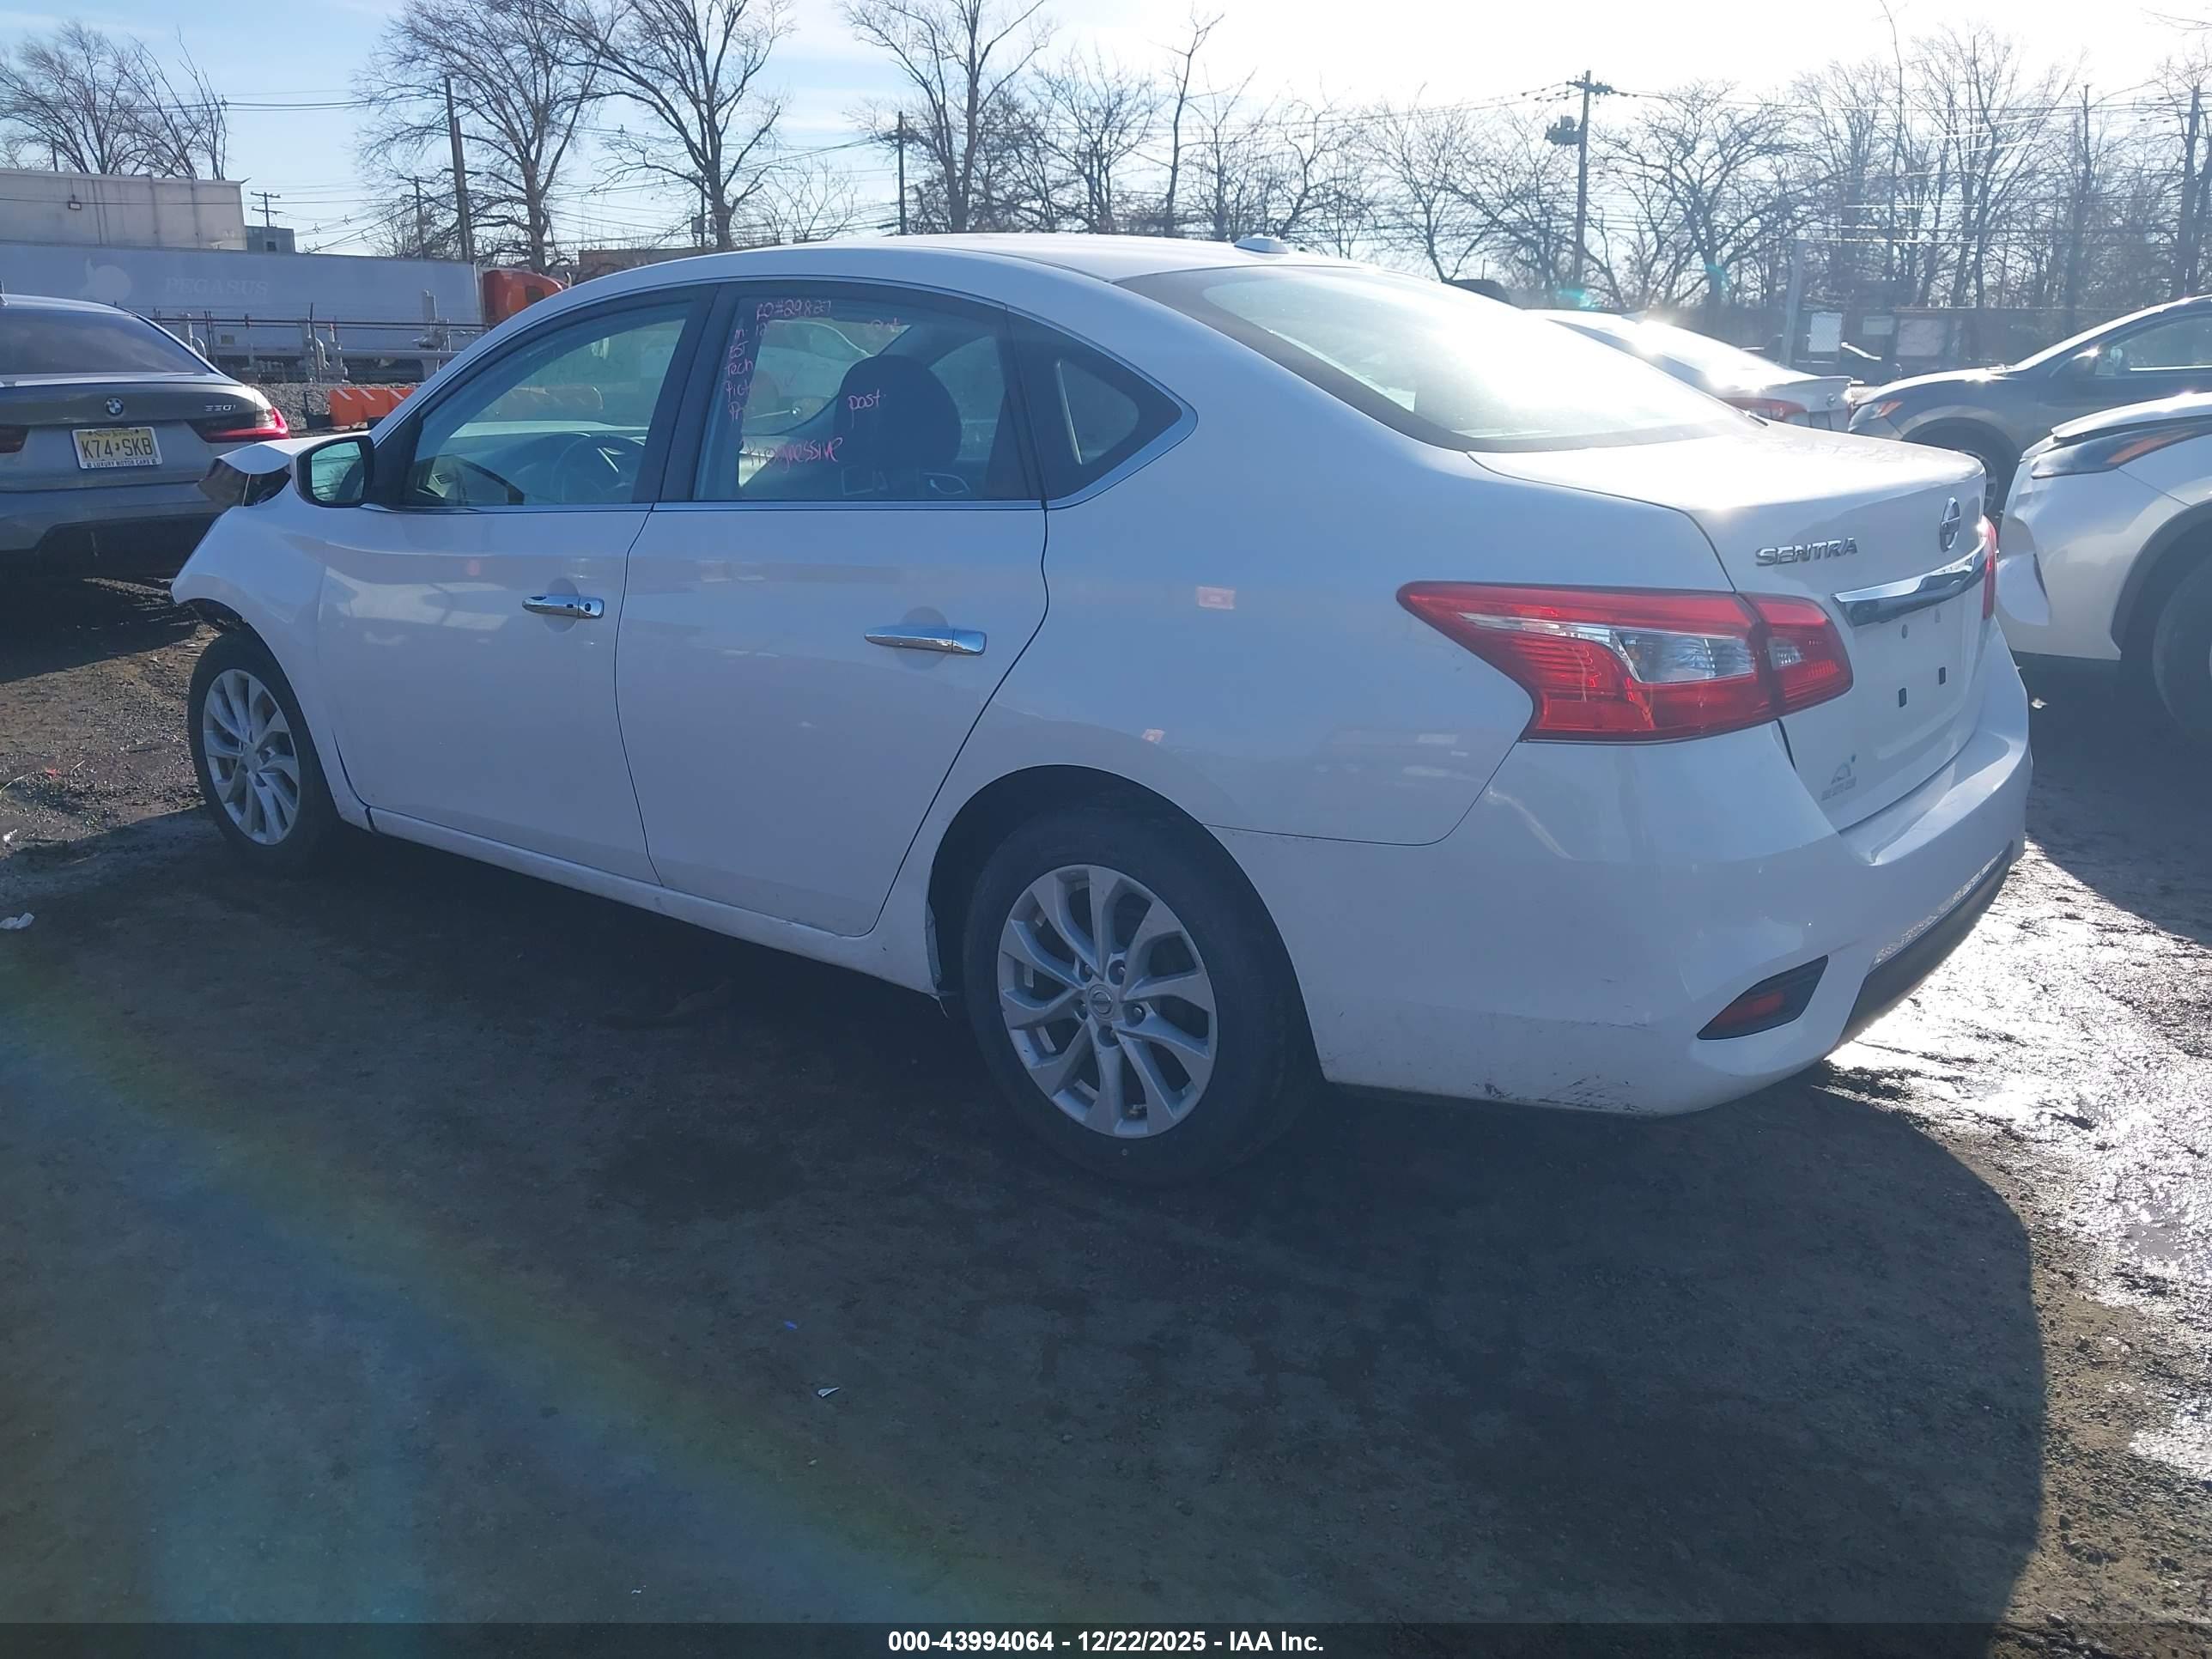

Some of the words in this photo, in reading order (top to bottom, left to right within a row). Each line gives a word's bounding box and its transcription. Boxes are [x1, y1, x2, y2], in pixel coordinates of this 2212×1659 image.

[164, 276, 269, 296] PEGASUS
[82, 439, 113, 459] K74
[122, 437, 153, 456] SKB
[1755, 537, 1858, 566] SENTRA
